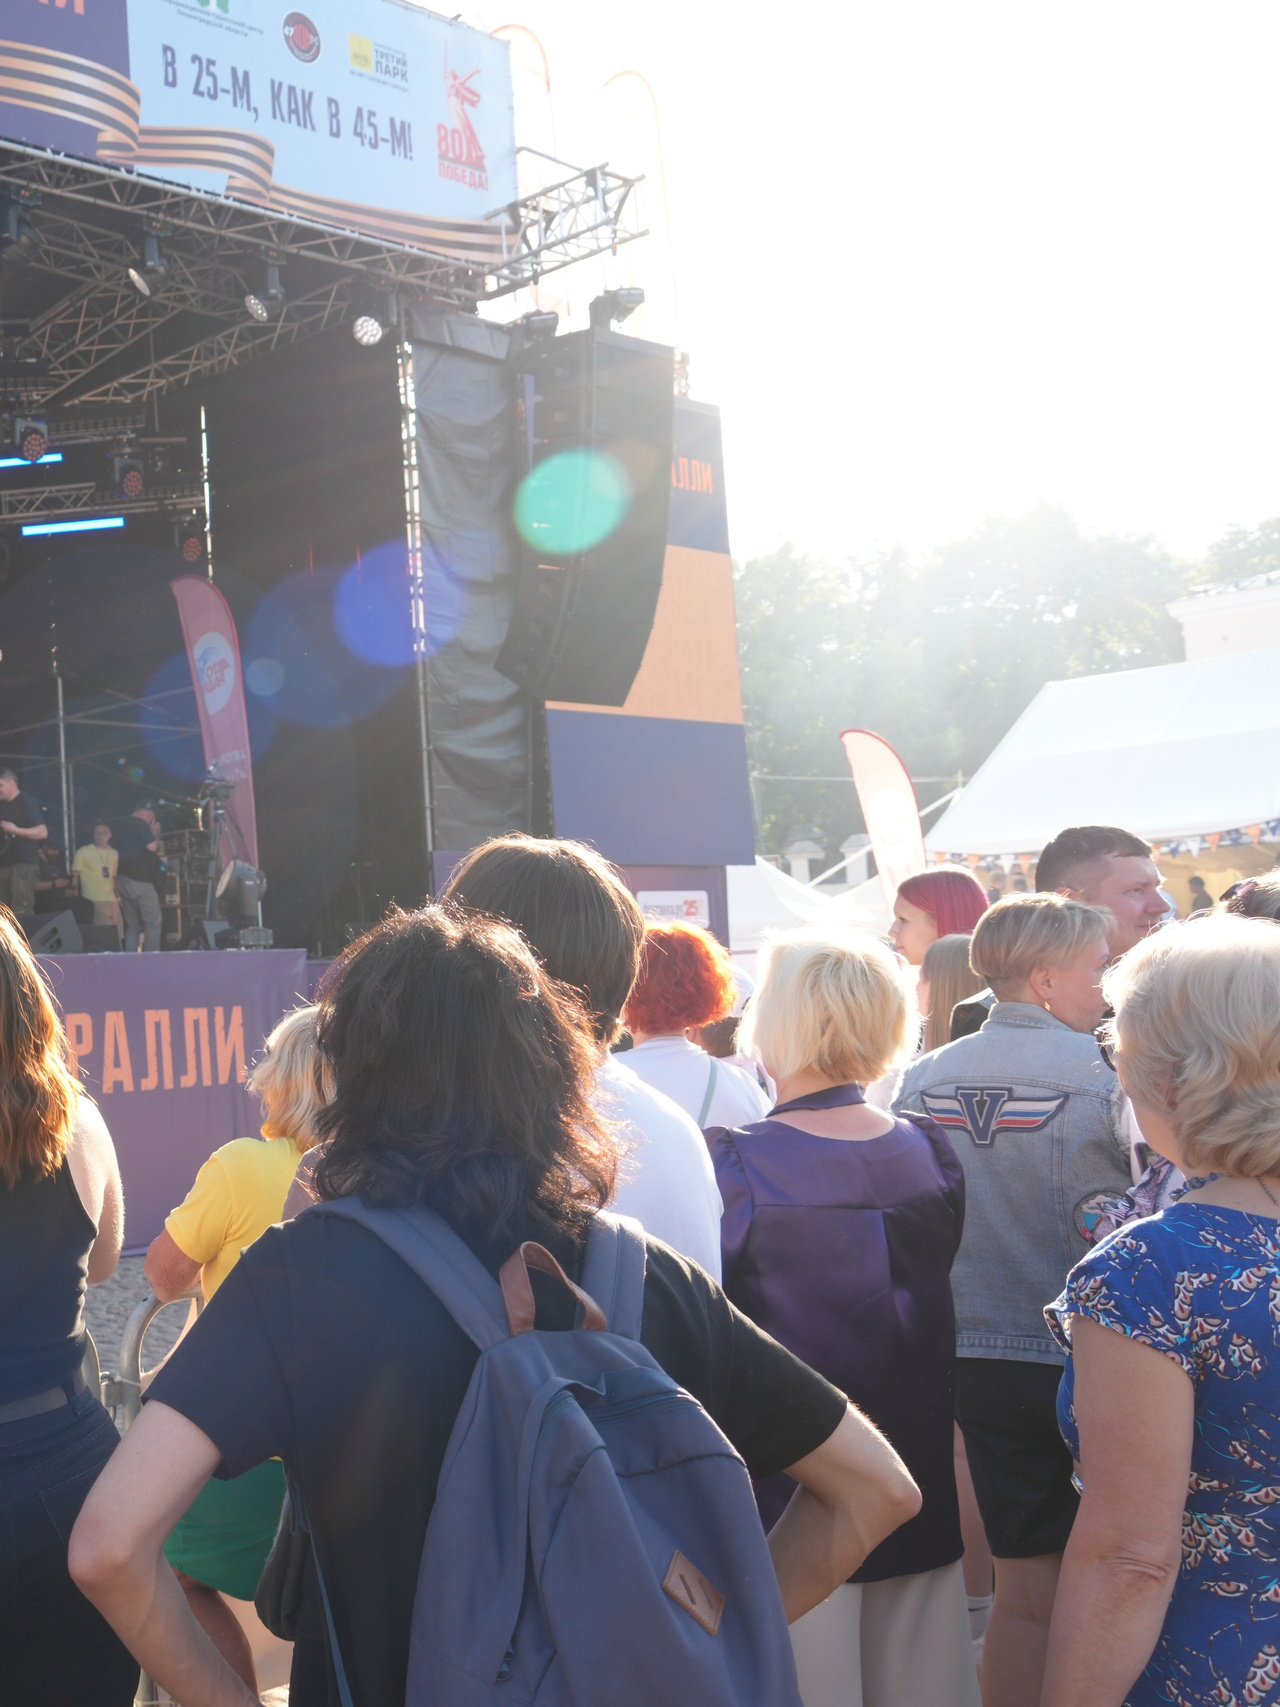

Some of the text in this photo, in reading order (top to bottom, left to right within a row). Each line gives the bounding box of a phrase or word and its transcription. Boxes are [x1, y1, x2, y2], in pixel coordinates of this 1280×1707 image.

[374, 48, 408, 69] ТРЕТИЙ
[375, 60, 409, 83] ПАРК
[162, 43, 177, 89] В
[190, 53, 259, 124] 25-М,
[270, 77, 317, 133] КАК
[326, 96, 341, 139] В
[352, 106, 414, 162] 45-М!
[436, 123, 464, 161] 80
[439, 160, 489, 191] ПОБЕДА!
[65, 1005, 248, 1094] РАЛЛИ
[957, 1089, 1010, 1145] V
